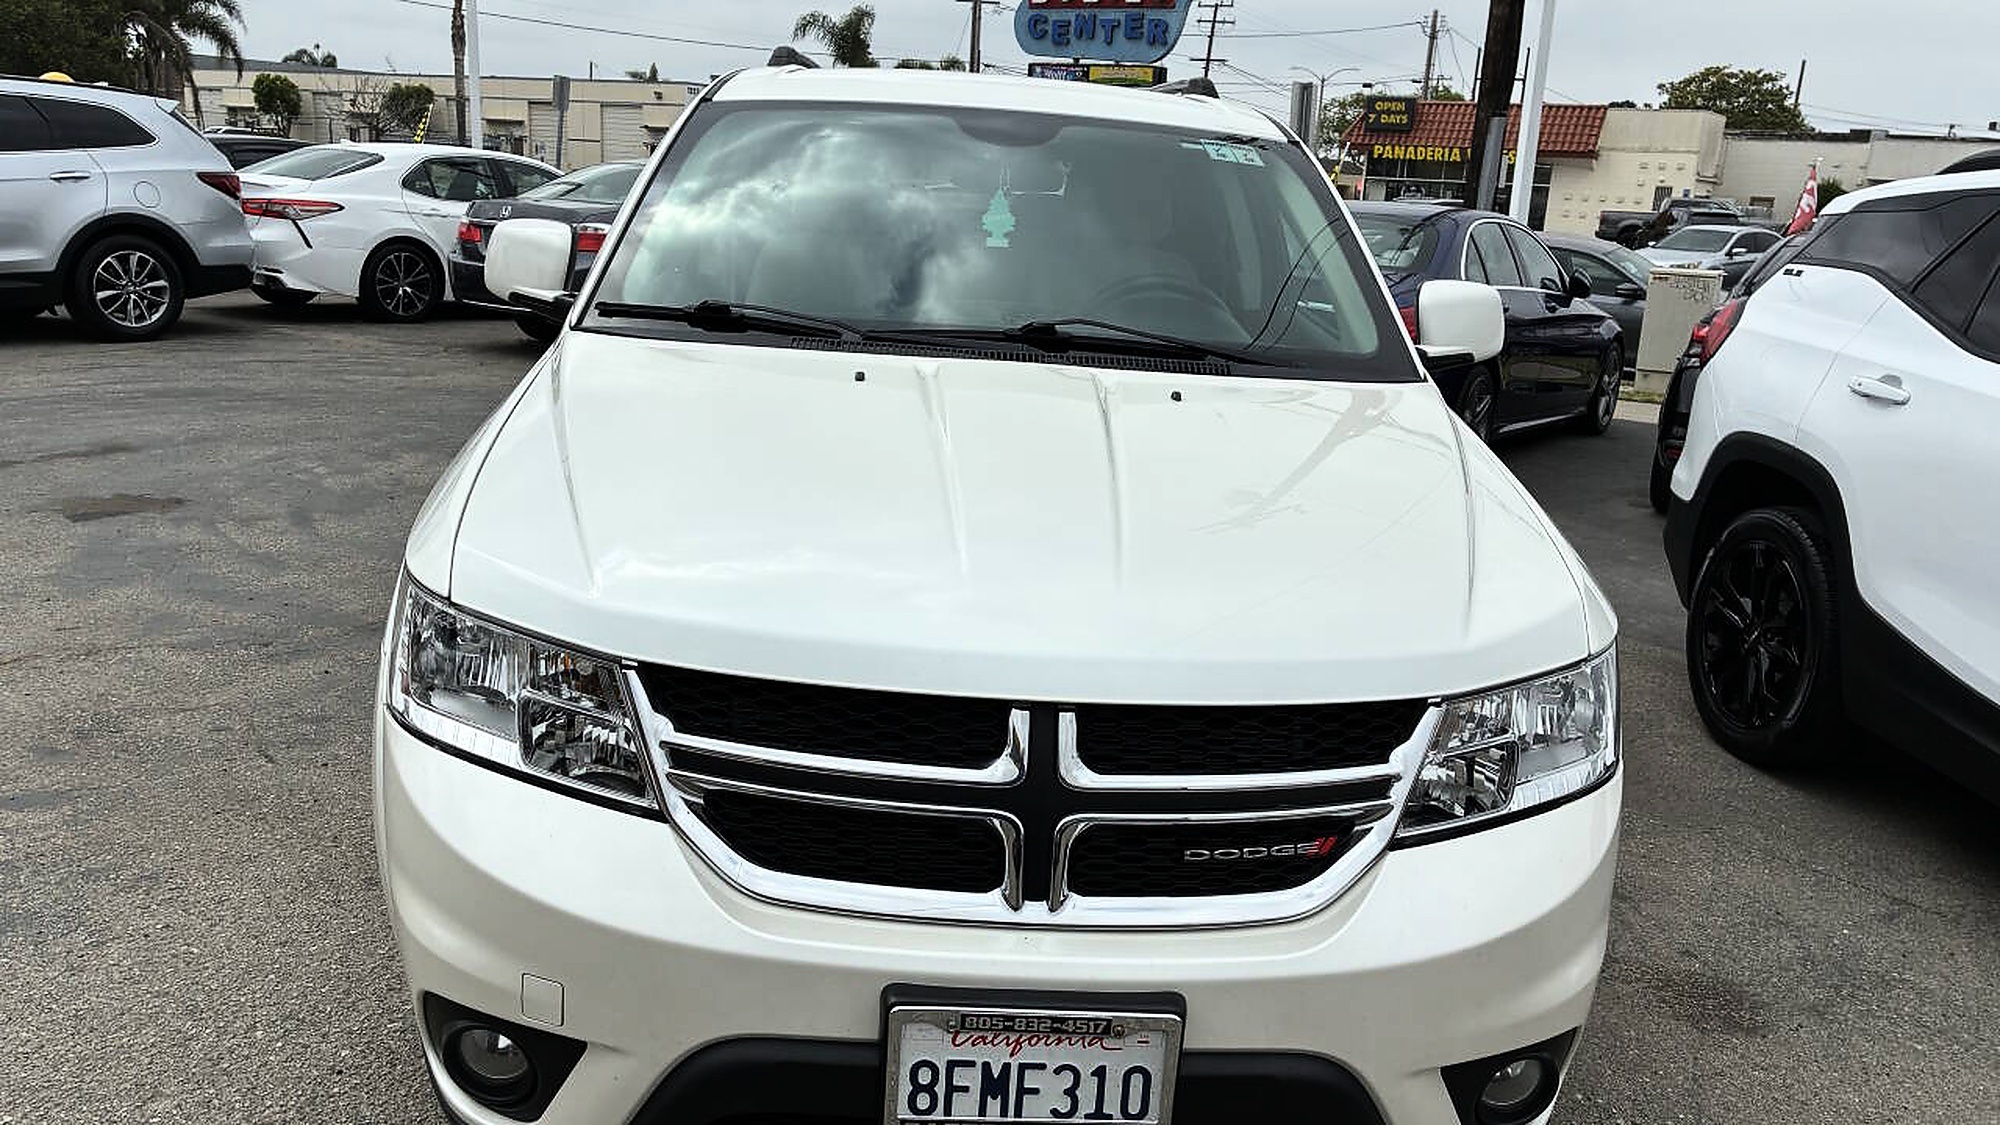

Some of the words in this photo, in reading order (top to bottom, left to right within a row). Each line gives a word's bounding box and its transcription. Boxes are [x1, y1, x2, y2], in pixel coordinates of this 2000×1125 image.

[1027, 12, 1168, 47] CENTER
[1375, 101, 1406, 112] OPEN
[1368, 113, 1376, 124] 7
[1381, 114, 1408, 124] DAYS
[1373, 145, 1462, 162] PANADERIA
[1184, 842, 1320, 860] DODGE
[965, 1016, 1107, 1034] 805-832-4517
[951, 1030, 1123, 1058] California
[907, 1059, 1153, 1121] 8FMF310
